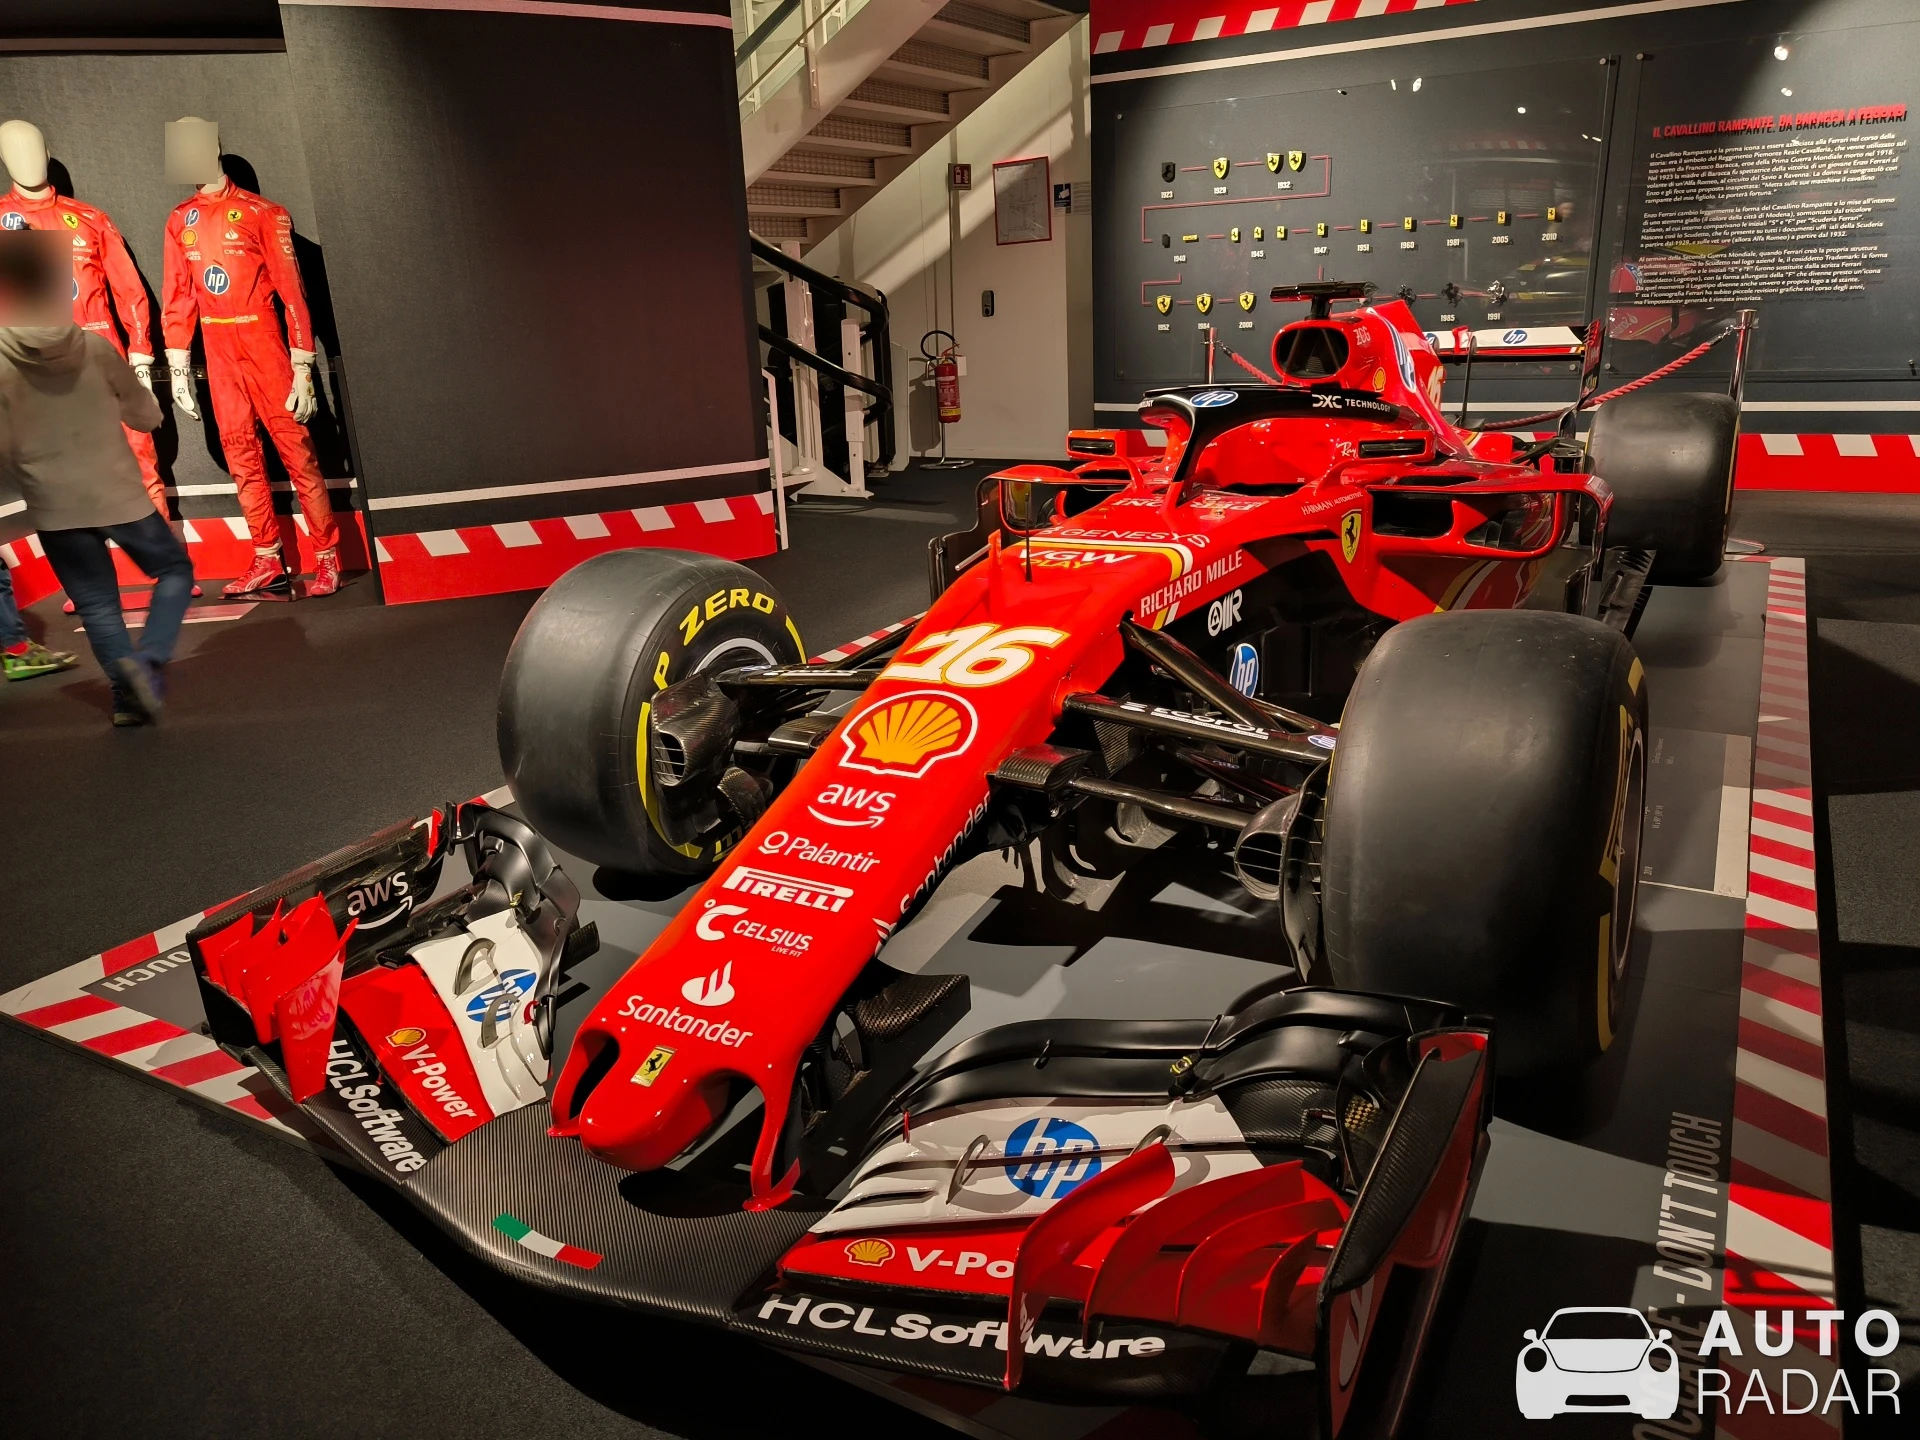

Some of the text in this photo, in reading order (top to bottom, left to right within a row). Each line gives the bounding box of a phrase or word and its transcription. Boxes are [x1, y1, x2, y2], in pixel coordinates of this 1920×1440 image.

[1664, 121, 1716, 136] CAVALLINO
[1161, 191, 1173, 199] 1923
[1277, 181, 1291, 189] 1932
[1314, 246, 1328, 254] 1947
[1447, 238, 1460, 247] 1981
[1492, 235, 1509, 244] 2005
[1541, 232, 1557, 241] 2010
[1157, 323, 1170, 331] 1952
[1238, 320, 1253, 328] 2000
[1487, 312, 1500, 321] 1991
[1312, 394, 1391, 413] DXC TECHNOLOGY
[1301, 491, 1363, 516] HARMAN AUTOMOTIVE
[1061, 528, 1210, 548] GENESYS
[1019, 549, 1137, 563] VGW
[1020, 559, 1094, 569] PLAY
[1140, 548, 1243, 618] RICHARD MILLE
[678, 587, 777, 646] ZERO
[875, 622, 1071, 688] 16
[1153, 707, 1270, 736] ECOPOL
[816, 782, 896, 814] aws
[783, 838, 880, 873] Palantir
[347, 871, 410, 917] aws
[722, 866, 854, 913] PIRELLI
[732, 919, 813, 951] CELSIUS
[771, 945, 803, 958] LIVE FIT
[101, 950, 192, 992] OUCH
[617, 995, 753, 1049] Santander
[399, 1043, 477, 1119] V-Power
[325, 1039, 428, 1172] HCLSoftware
[1012, 1117, 1096, 1198] hp
[1653, 1111, 1722, 1291] DON'T TOUCH
[906, 1246, 1015, 1279] V-Po
[757, 1293, 1167, 1361] HCLSoftware
